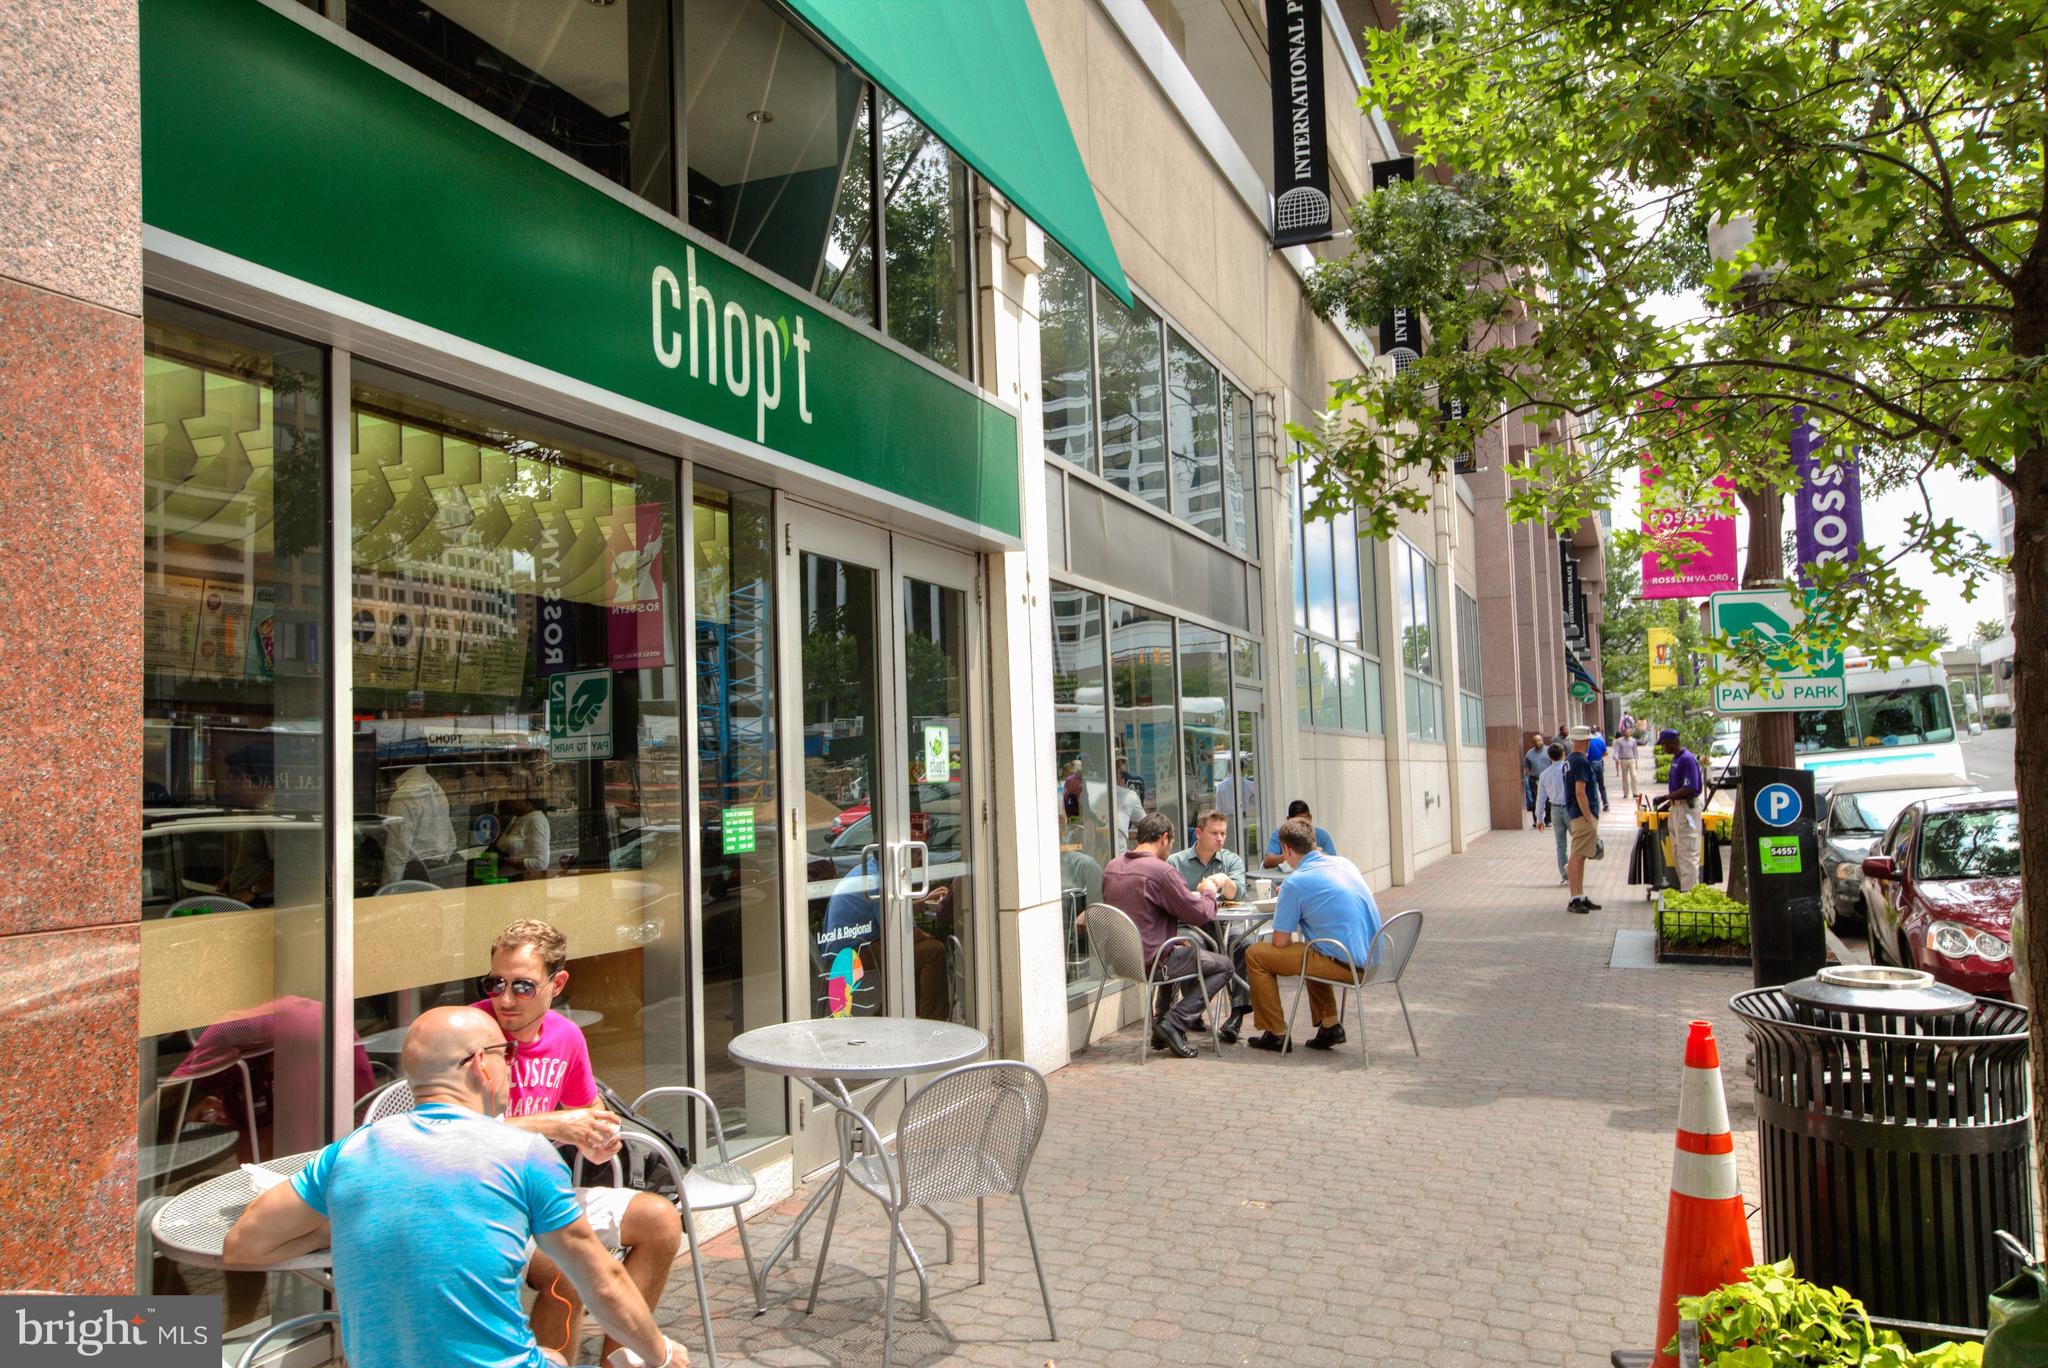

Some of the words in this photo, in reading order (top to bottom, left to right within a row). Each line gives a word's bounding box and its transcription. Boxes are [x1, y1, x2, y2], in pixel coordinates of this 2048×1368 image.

[1287, 0, 1304, 14] P
[1288, 18, 1312, 181] INTERNATIONAL
[1394, 304, 1408, 342] INTE
[651, 245, 813, 443] chop't
[1721, 687, 1753, 701] PAY
[1793, 685, 1839, 699] PARK
[1770, 791, 1790, 820] P
[1771, 847, 1797, 856] 54557
[817, 928, 837, 945] Local
[843, 920, 873, 939] Regional
